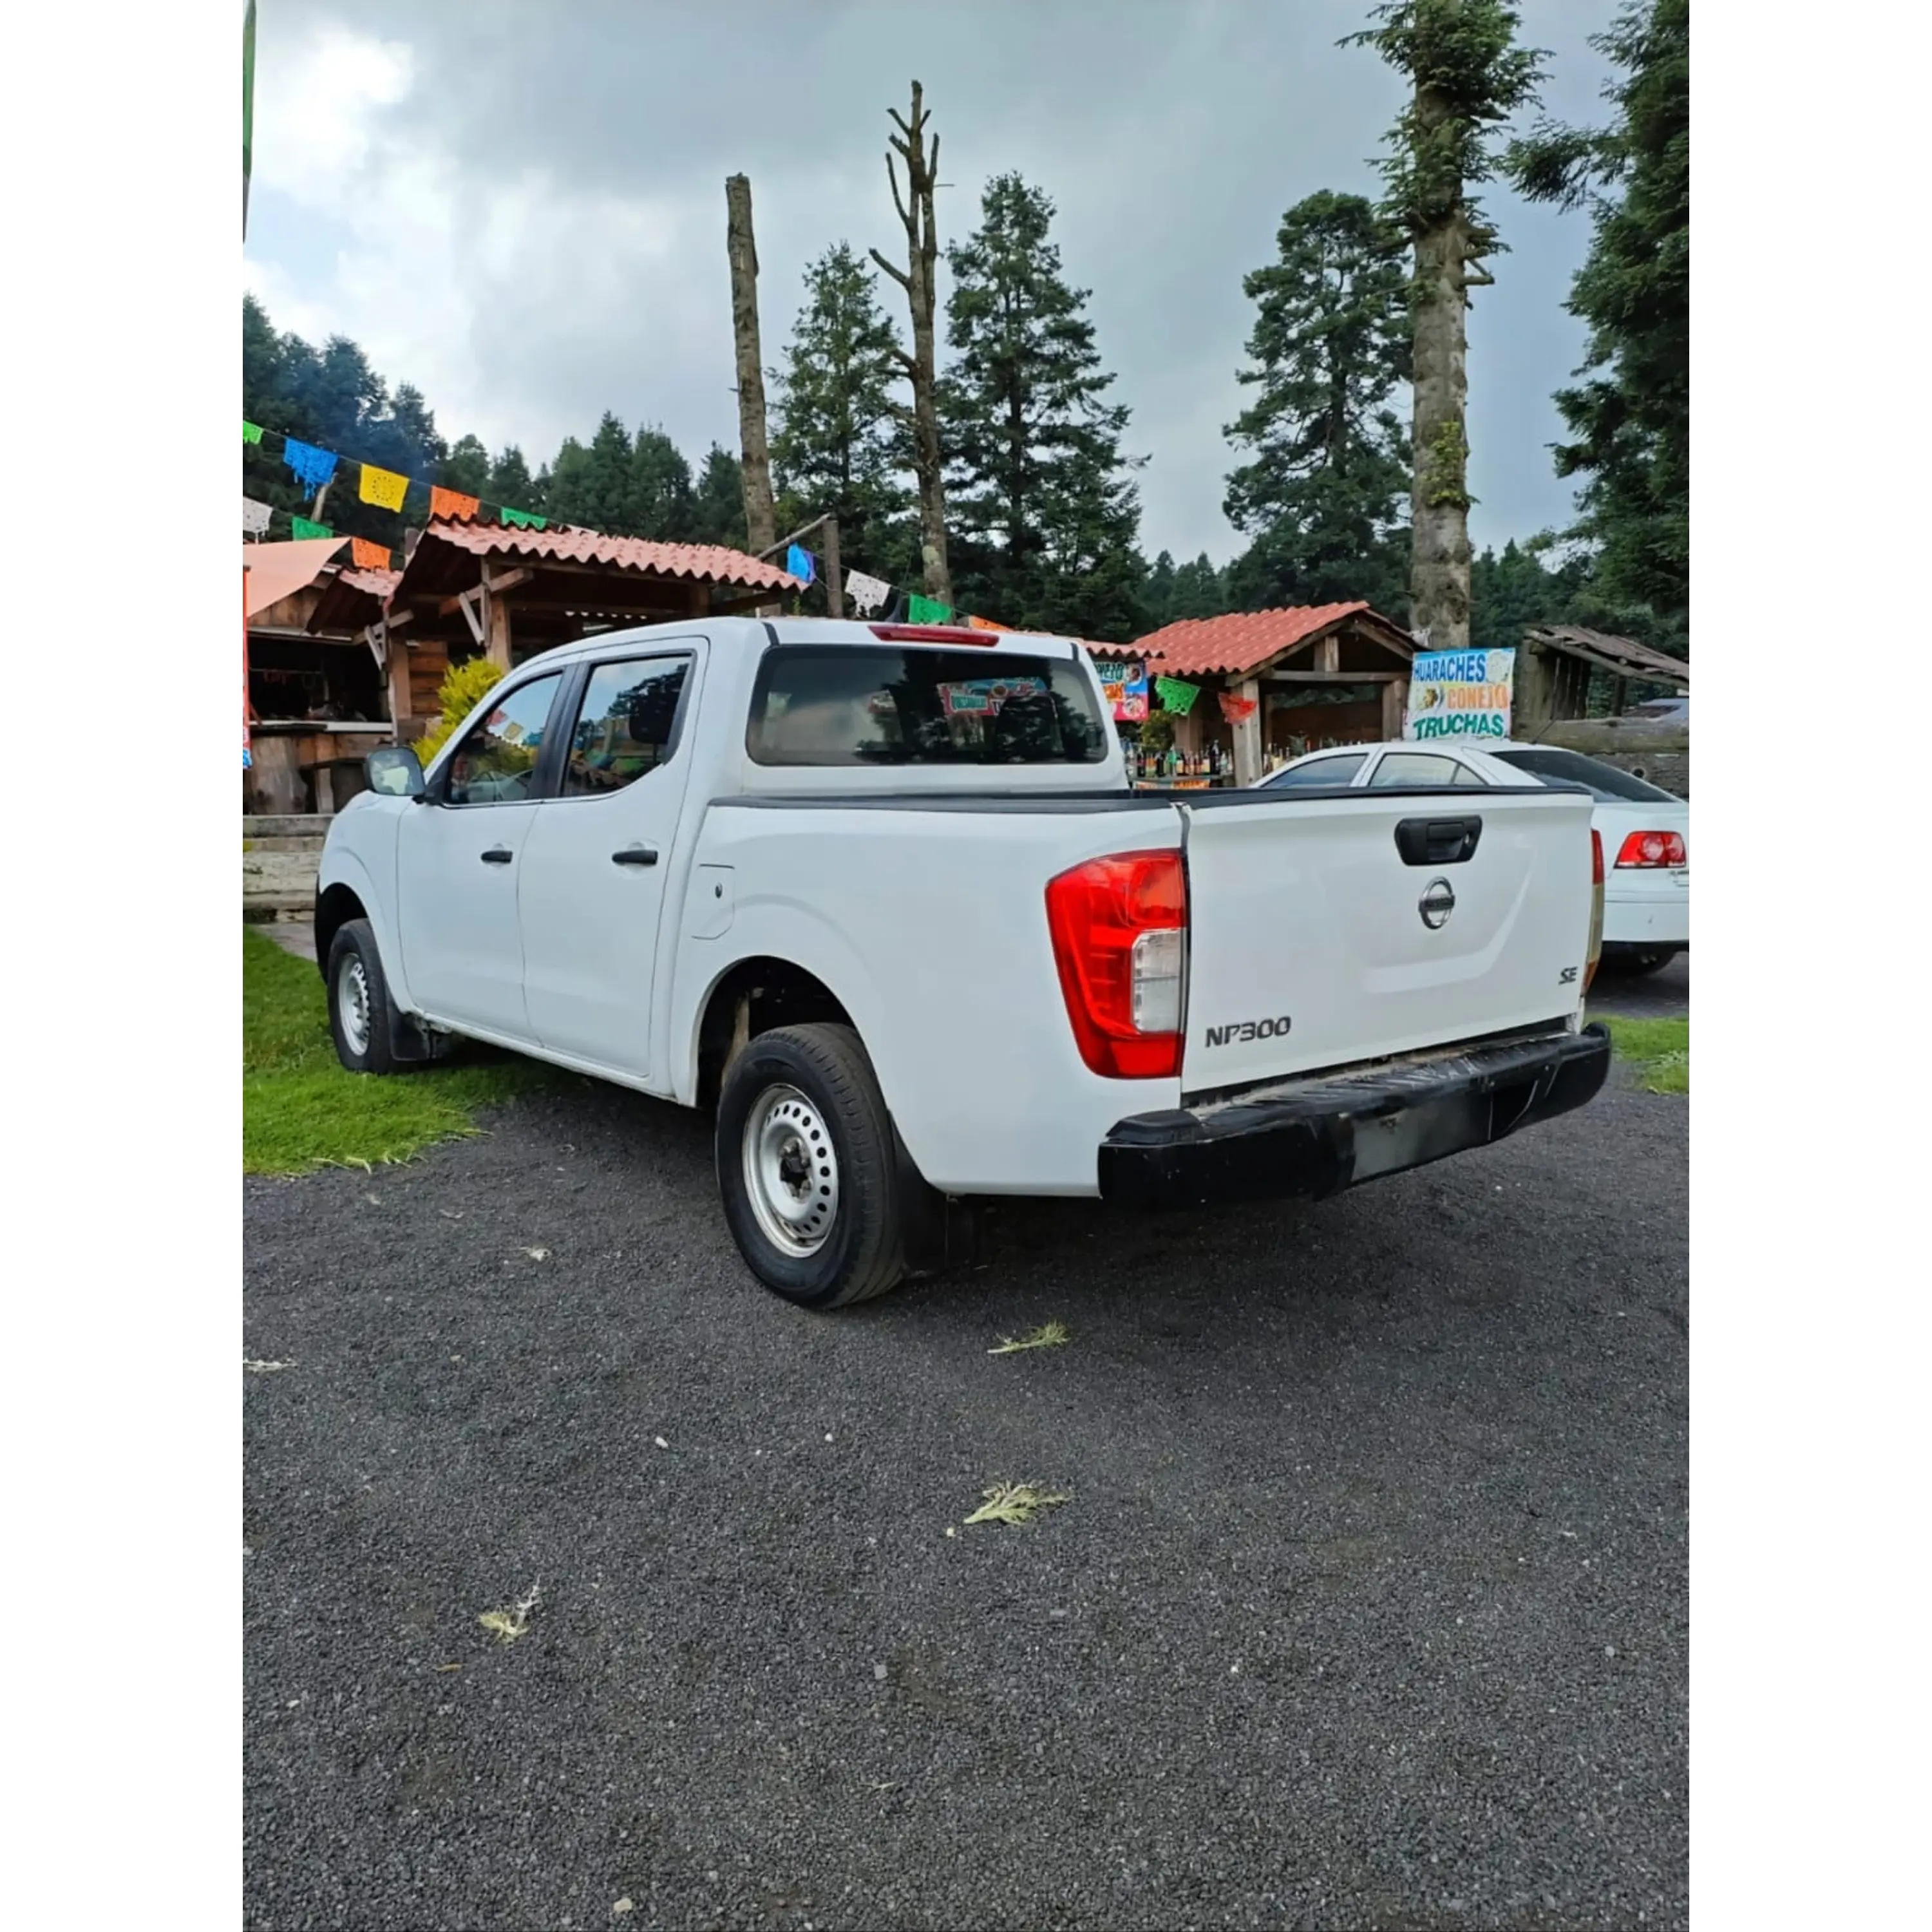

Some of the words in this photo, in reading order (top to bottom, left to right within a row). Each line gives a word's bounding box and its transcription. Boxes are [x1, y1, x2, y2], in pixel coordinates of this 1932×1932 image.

[1414, 653, 1486, 682] HUARACHES
[1446, 684, 1508, 709] CONEJO
[1413, 713, 1504, 741] TRUCHAS
[1558, 966, 1578, 985] SE
[1205, 1016, 1292, 1048] NP300
